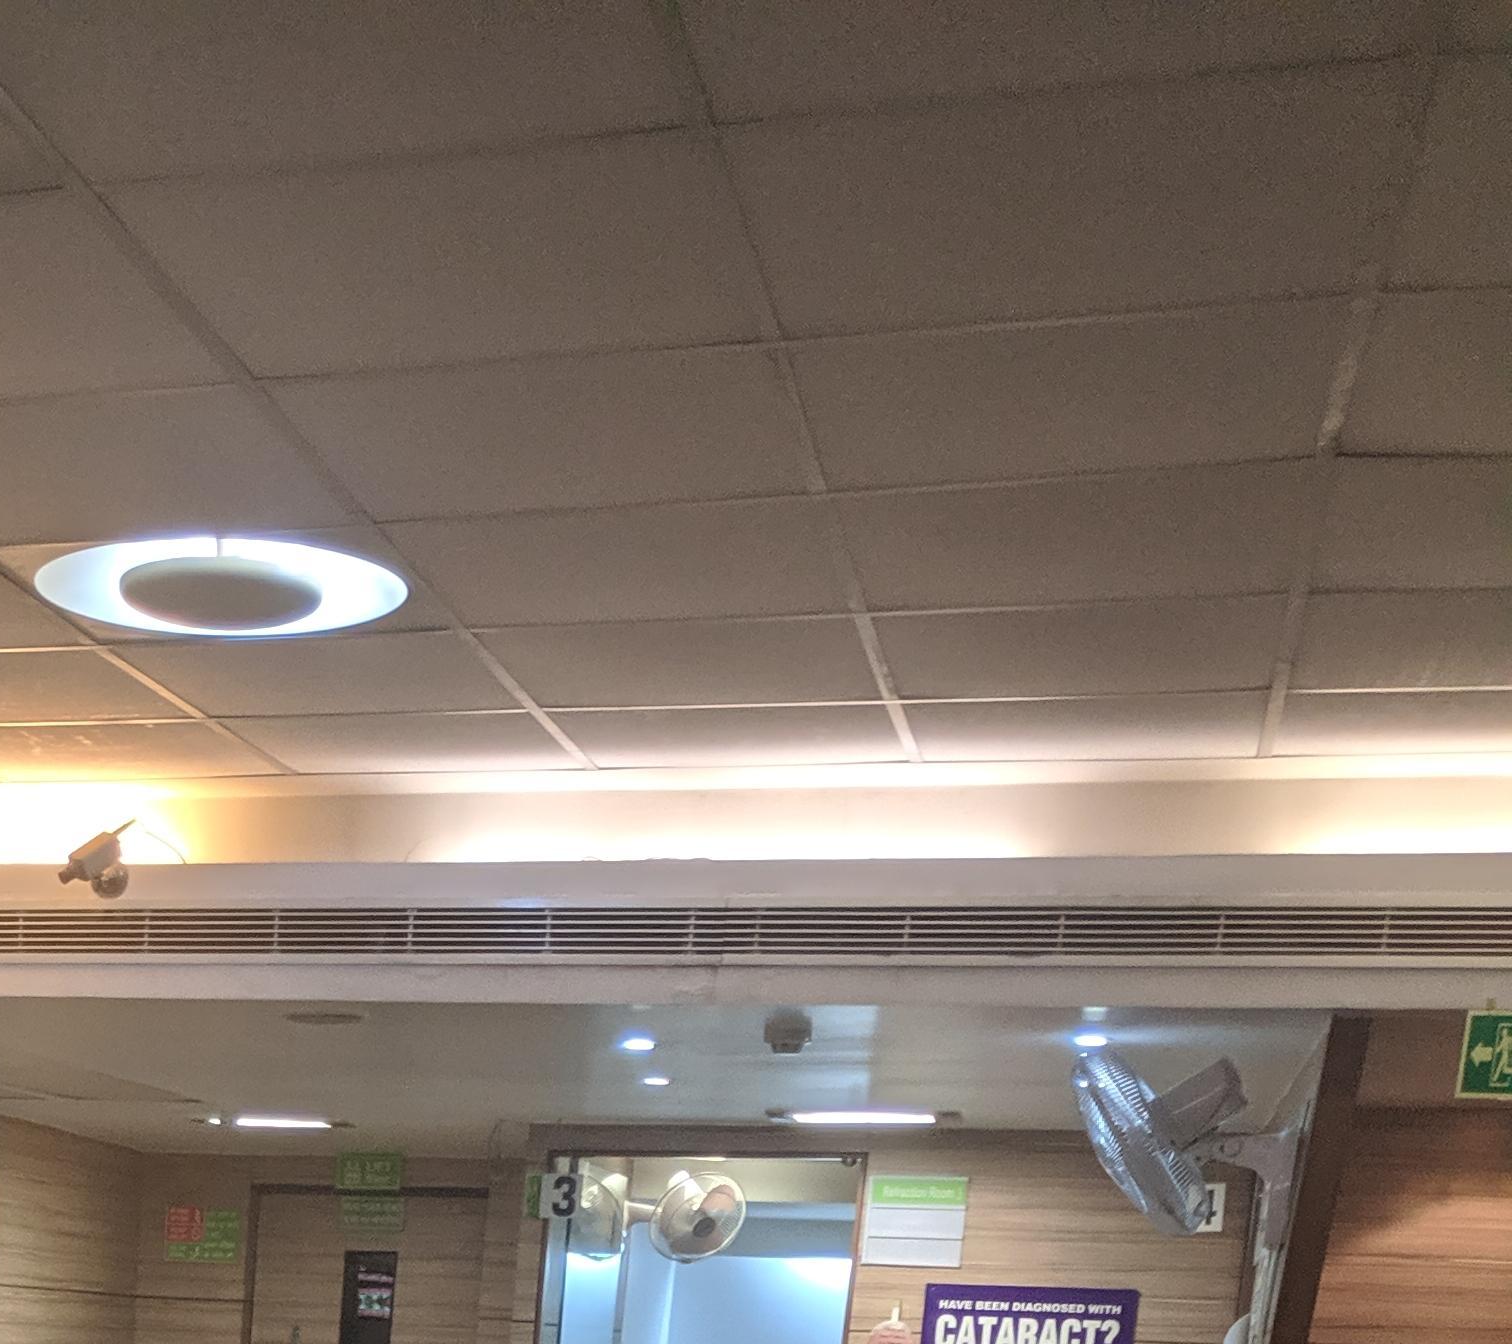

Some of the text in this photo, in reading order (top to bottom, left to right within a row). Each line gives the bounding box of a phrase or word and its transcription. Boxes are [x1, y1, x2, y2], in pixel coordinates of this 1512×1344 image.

[551, 1175, 577, 1218] 3
[938, 1299, 1123, 1315] HAVE BEEN DIAGNOSED WITH
